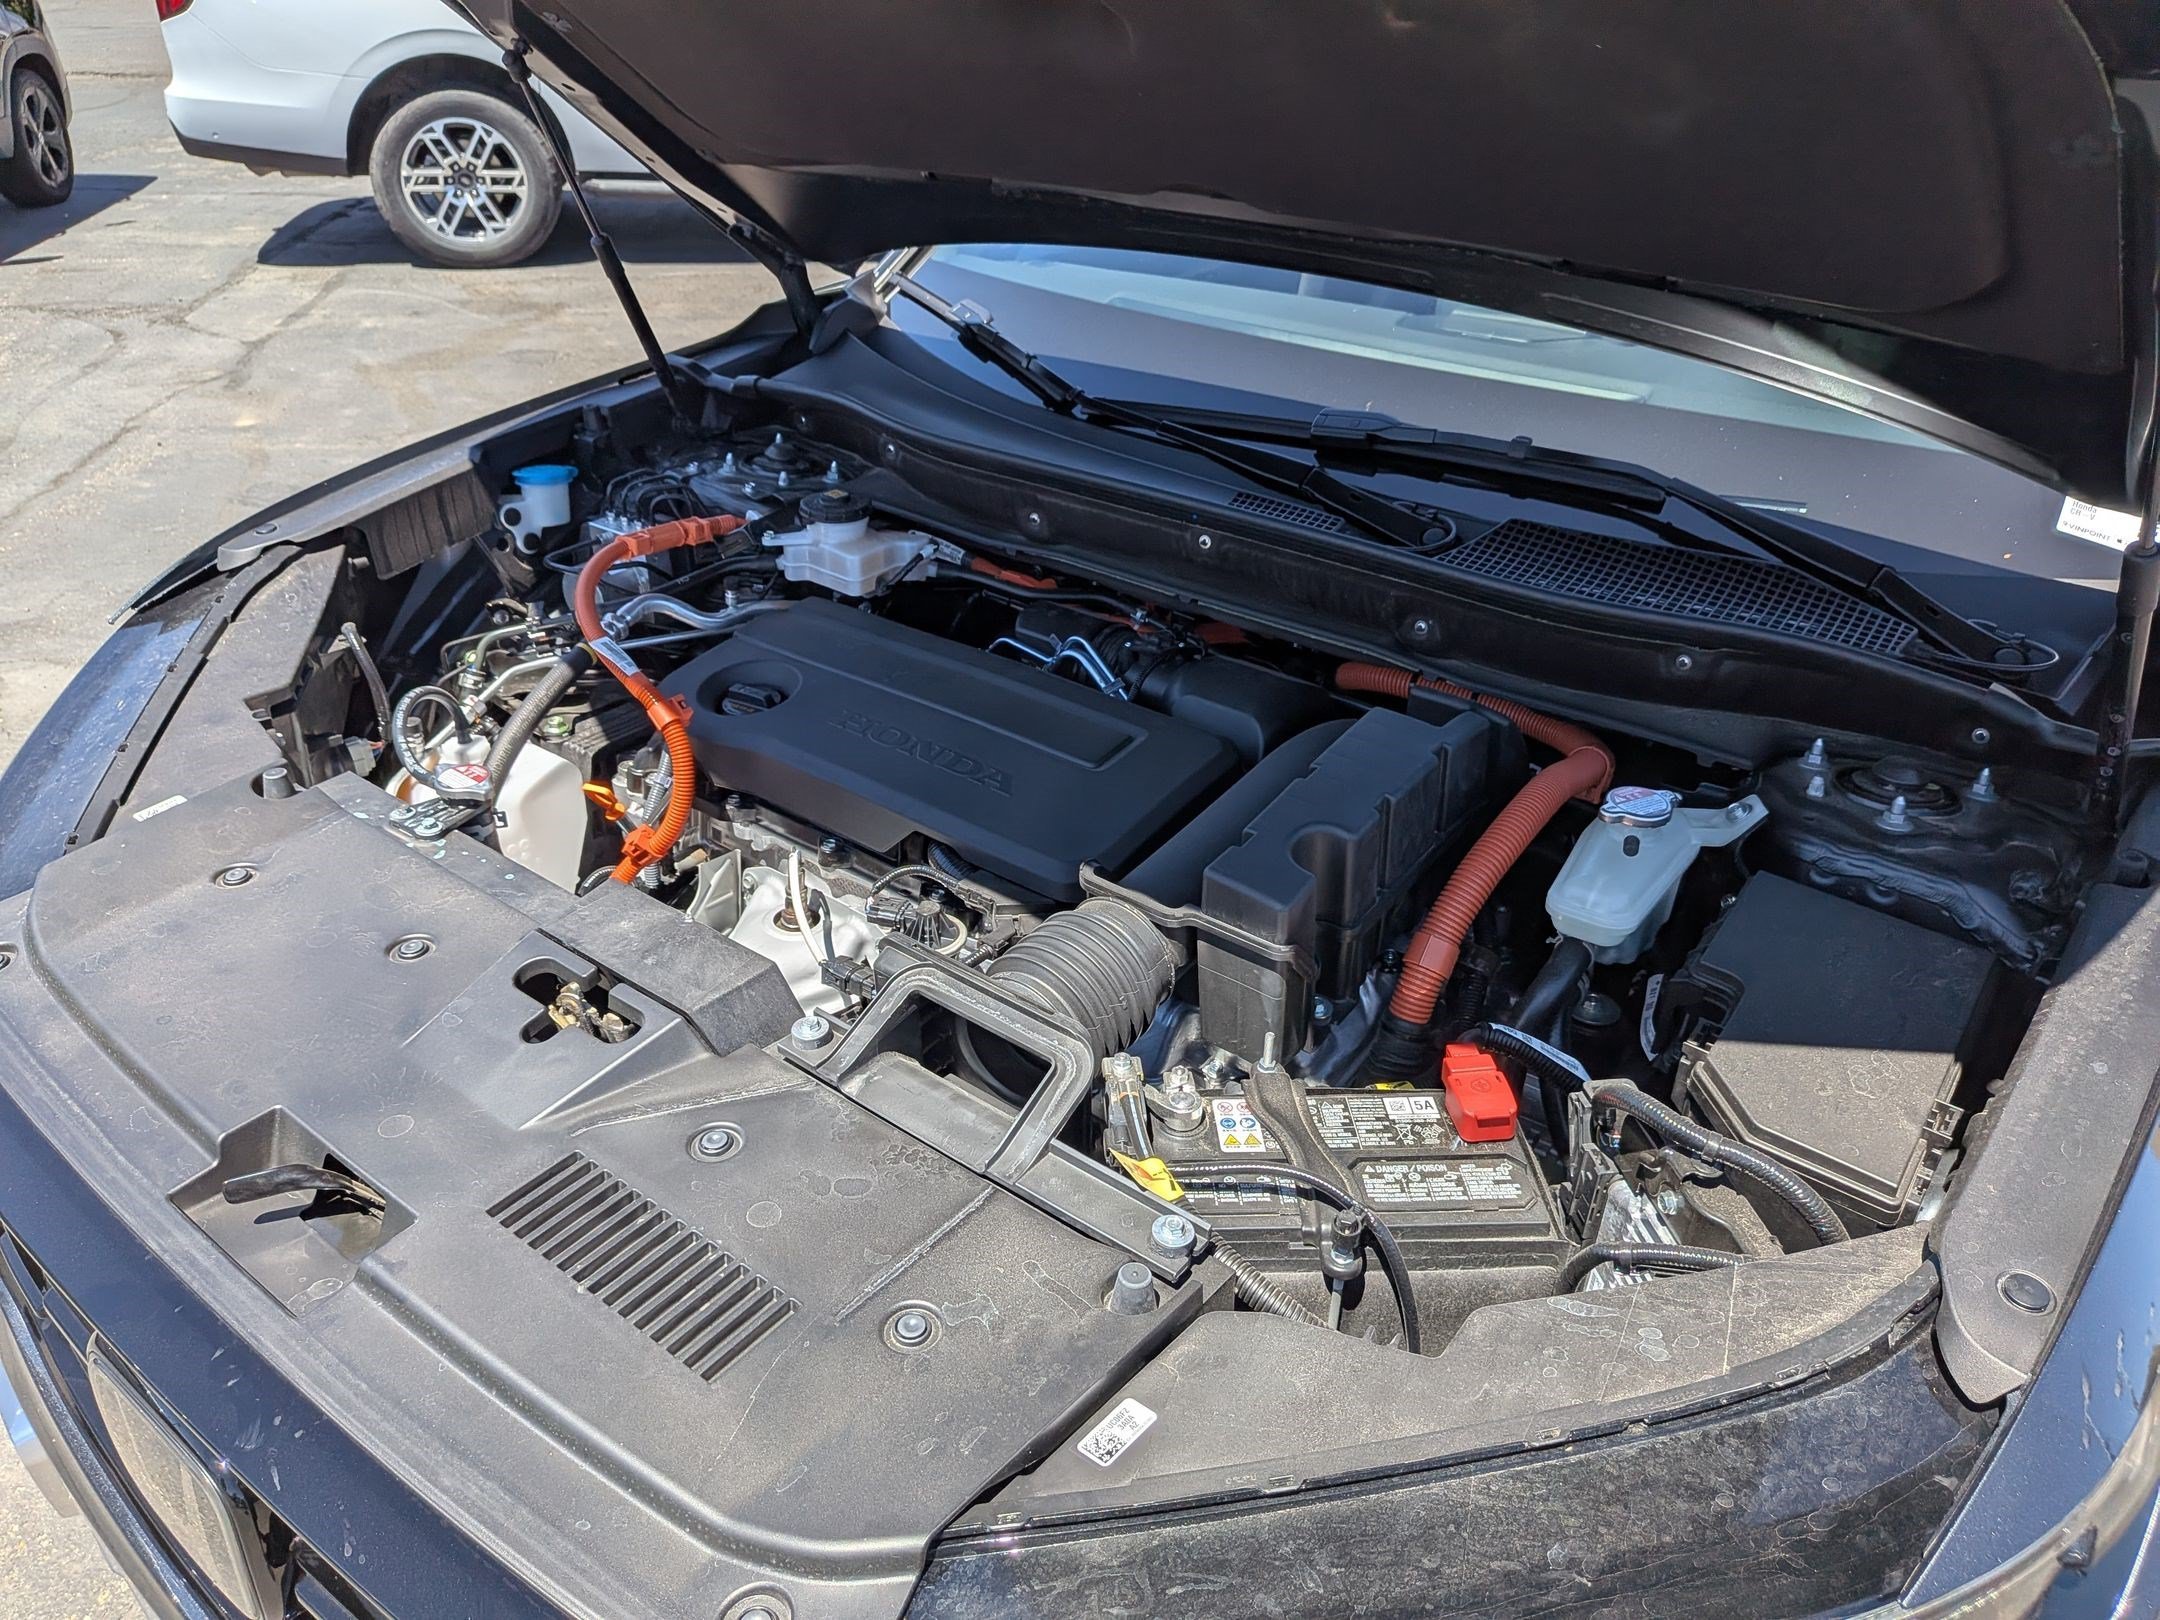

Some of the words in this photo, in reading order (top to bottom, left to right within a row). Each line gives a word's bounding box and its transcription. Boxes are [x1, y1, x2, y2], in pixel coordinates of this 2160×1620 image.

[2072, 500, 2097, 514] Honda
[2069, 523, 2111, 542] VINPOINT
[828, 708, 1015, 797] HONDA
[1413, 1100, 1435, 1111] 5A
[1375, 1164, 1409, 1173] DANGER
[1416, 1164, 1448, 1172] POISON
